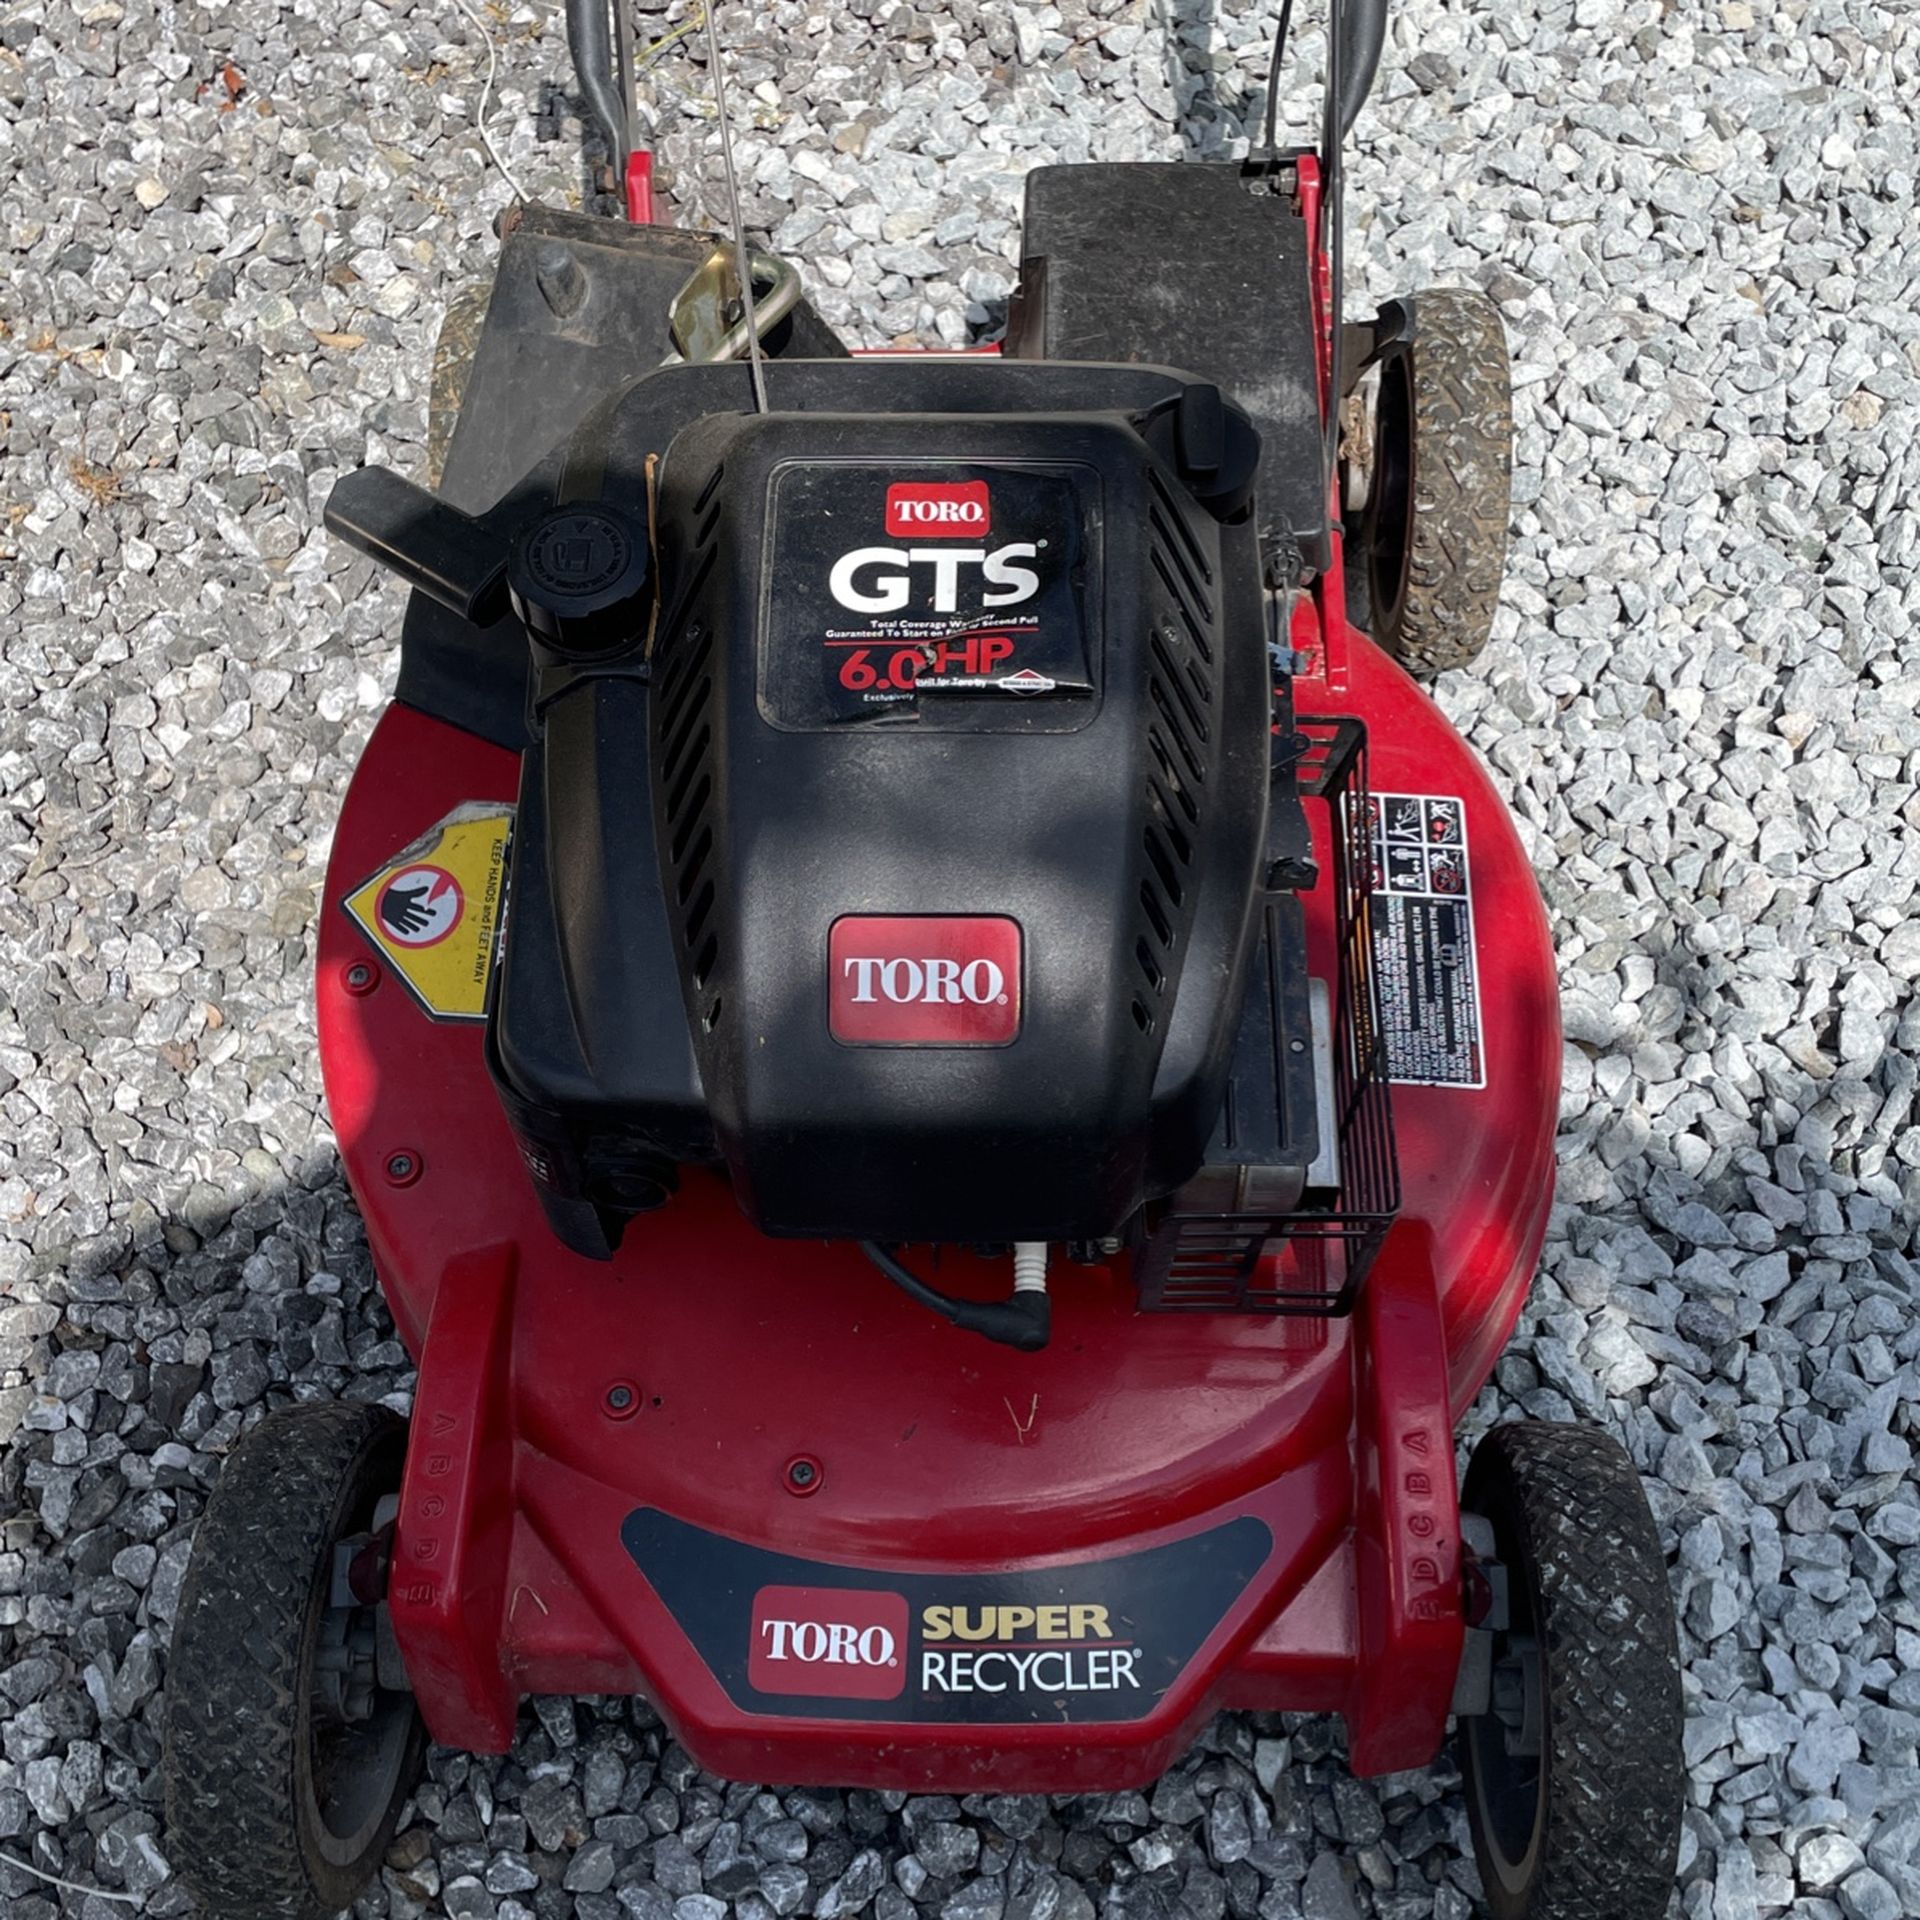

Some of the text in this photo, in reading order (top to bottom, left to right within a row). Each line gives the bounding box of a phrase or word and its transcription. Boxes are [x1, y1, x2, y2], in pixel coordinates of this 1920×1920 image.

[894, 500, 984, 522] TORO
[829, 543, 1040, 614] GTS
[825, 628, 884, 638] Guaranteed
[886, 628, 901, 638] To
[902, 628, 929, 638] Start
[930, 630, 944, 638] on
[982, 617, 1018, 627] Second
[1019, 615, 1039, 624] Pull
[870, 619, 898, 629] Total
[899, 619, 947, 630] Coverage
[839, 636, 1015, 691] 6.0 HP
[863, 693, 915, 702] Exclusively
[473, 838, 503, 985] KEEP HANDS and FEET AWAY
[844, 957, 1004, 1005] TORO
[421, 1495, 445, 1518] C
[1408, 1514, 1433, 1537] C
[922, 1603, 1113, 1641] SUPER
[762, 1619, 895, 1666] TORO
[922, 1648, 1141, 1693] RECYCLER
